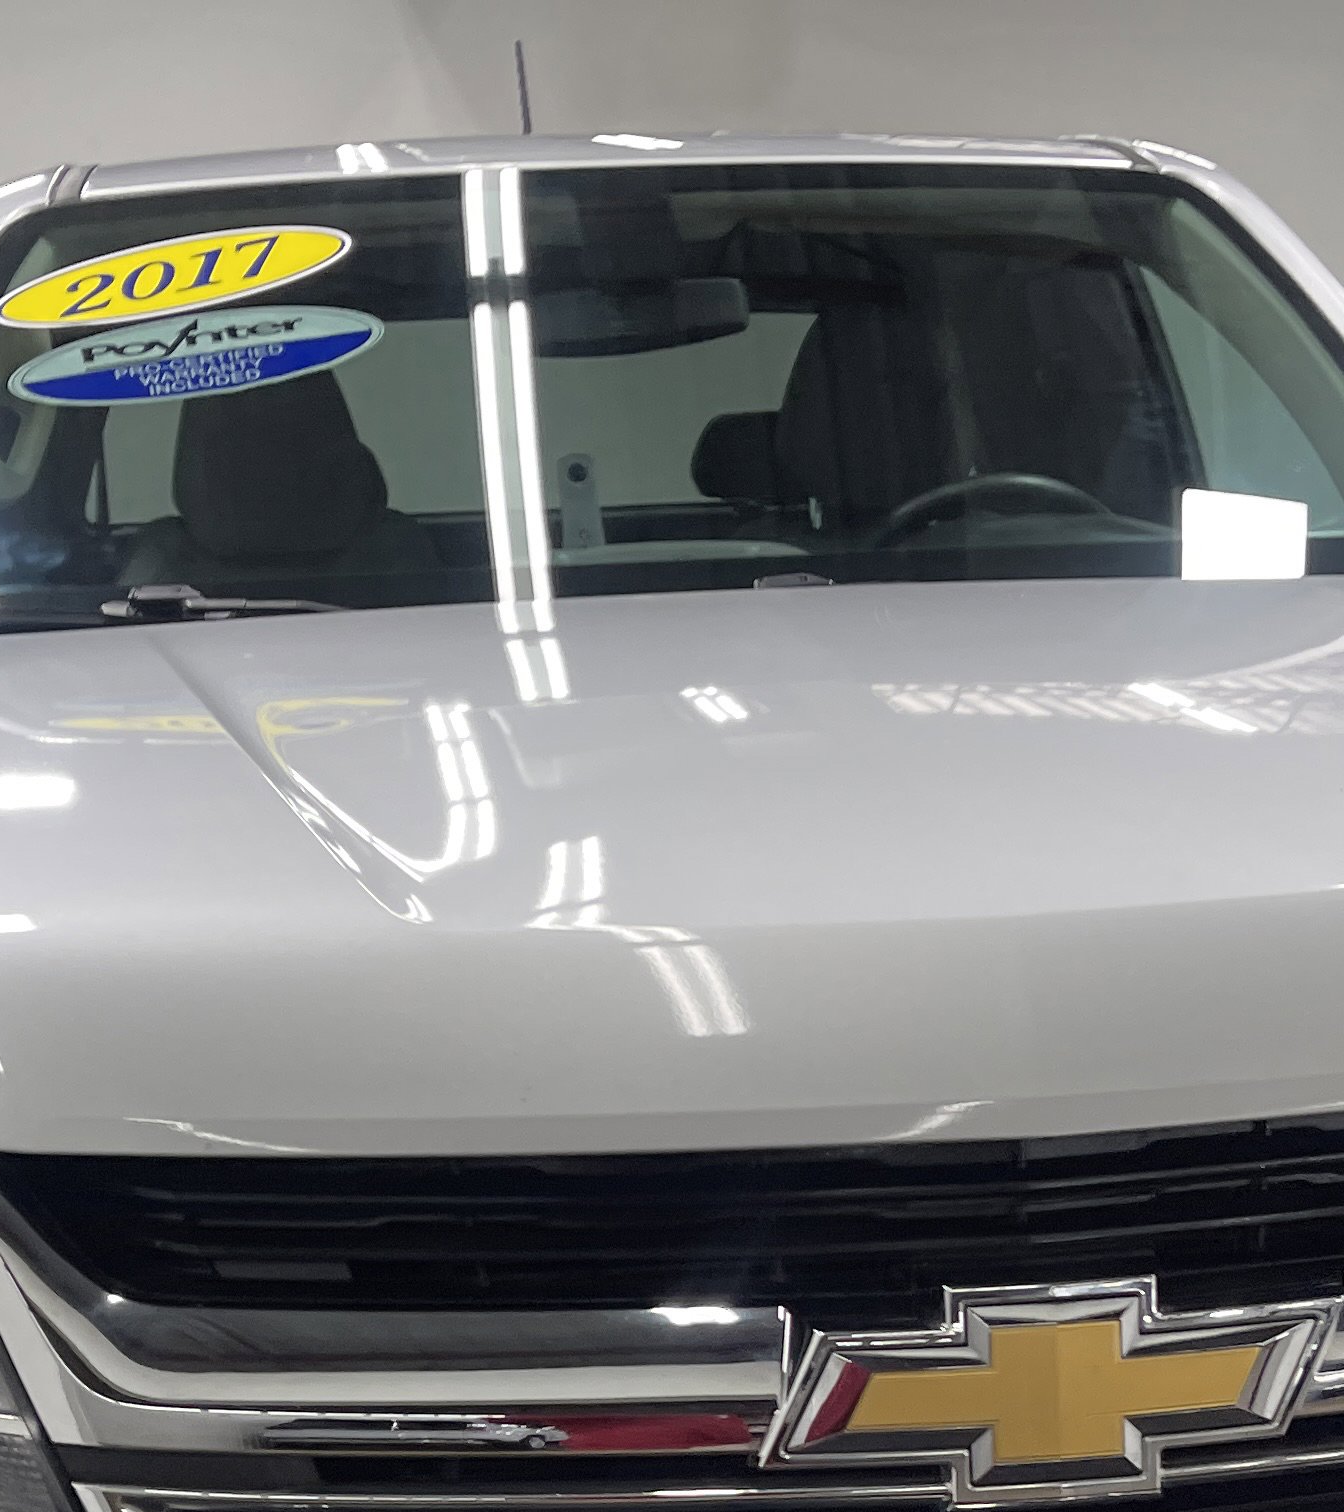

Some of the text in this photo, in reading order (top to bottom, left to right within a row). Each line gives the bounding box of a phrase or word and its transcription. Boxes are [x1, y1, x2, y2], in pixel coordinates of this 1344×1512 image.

[60, 235, 280, 319] 2017
[139, 357, 263, 387] WARRANTY
[149, 368, 261, 397] INCLUDED
